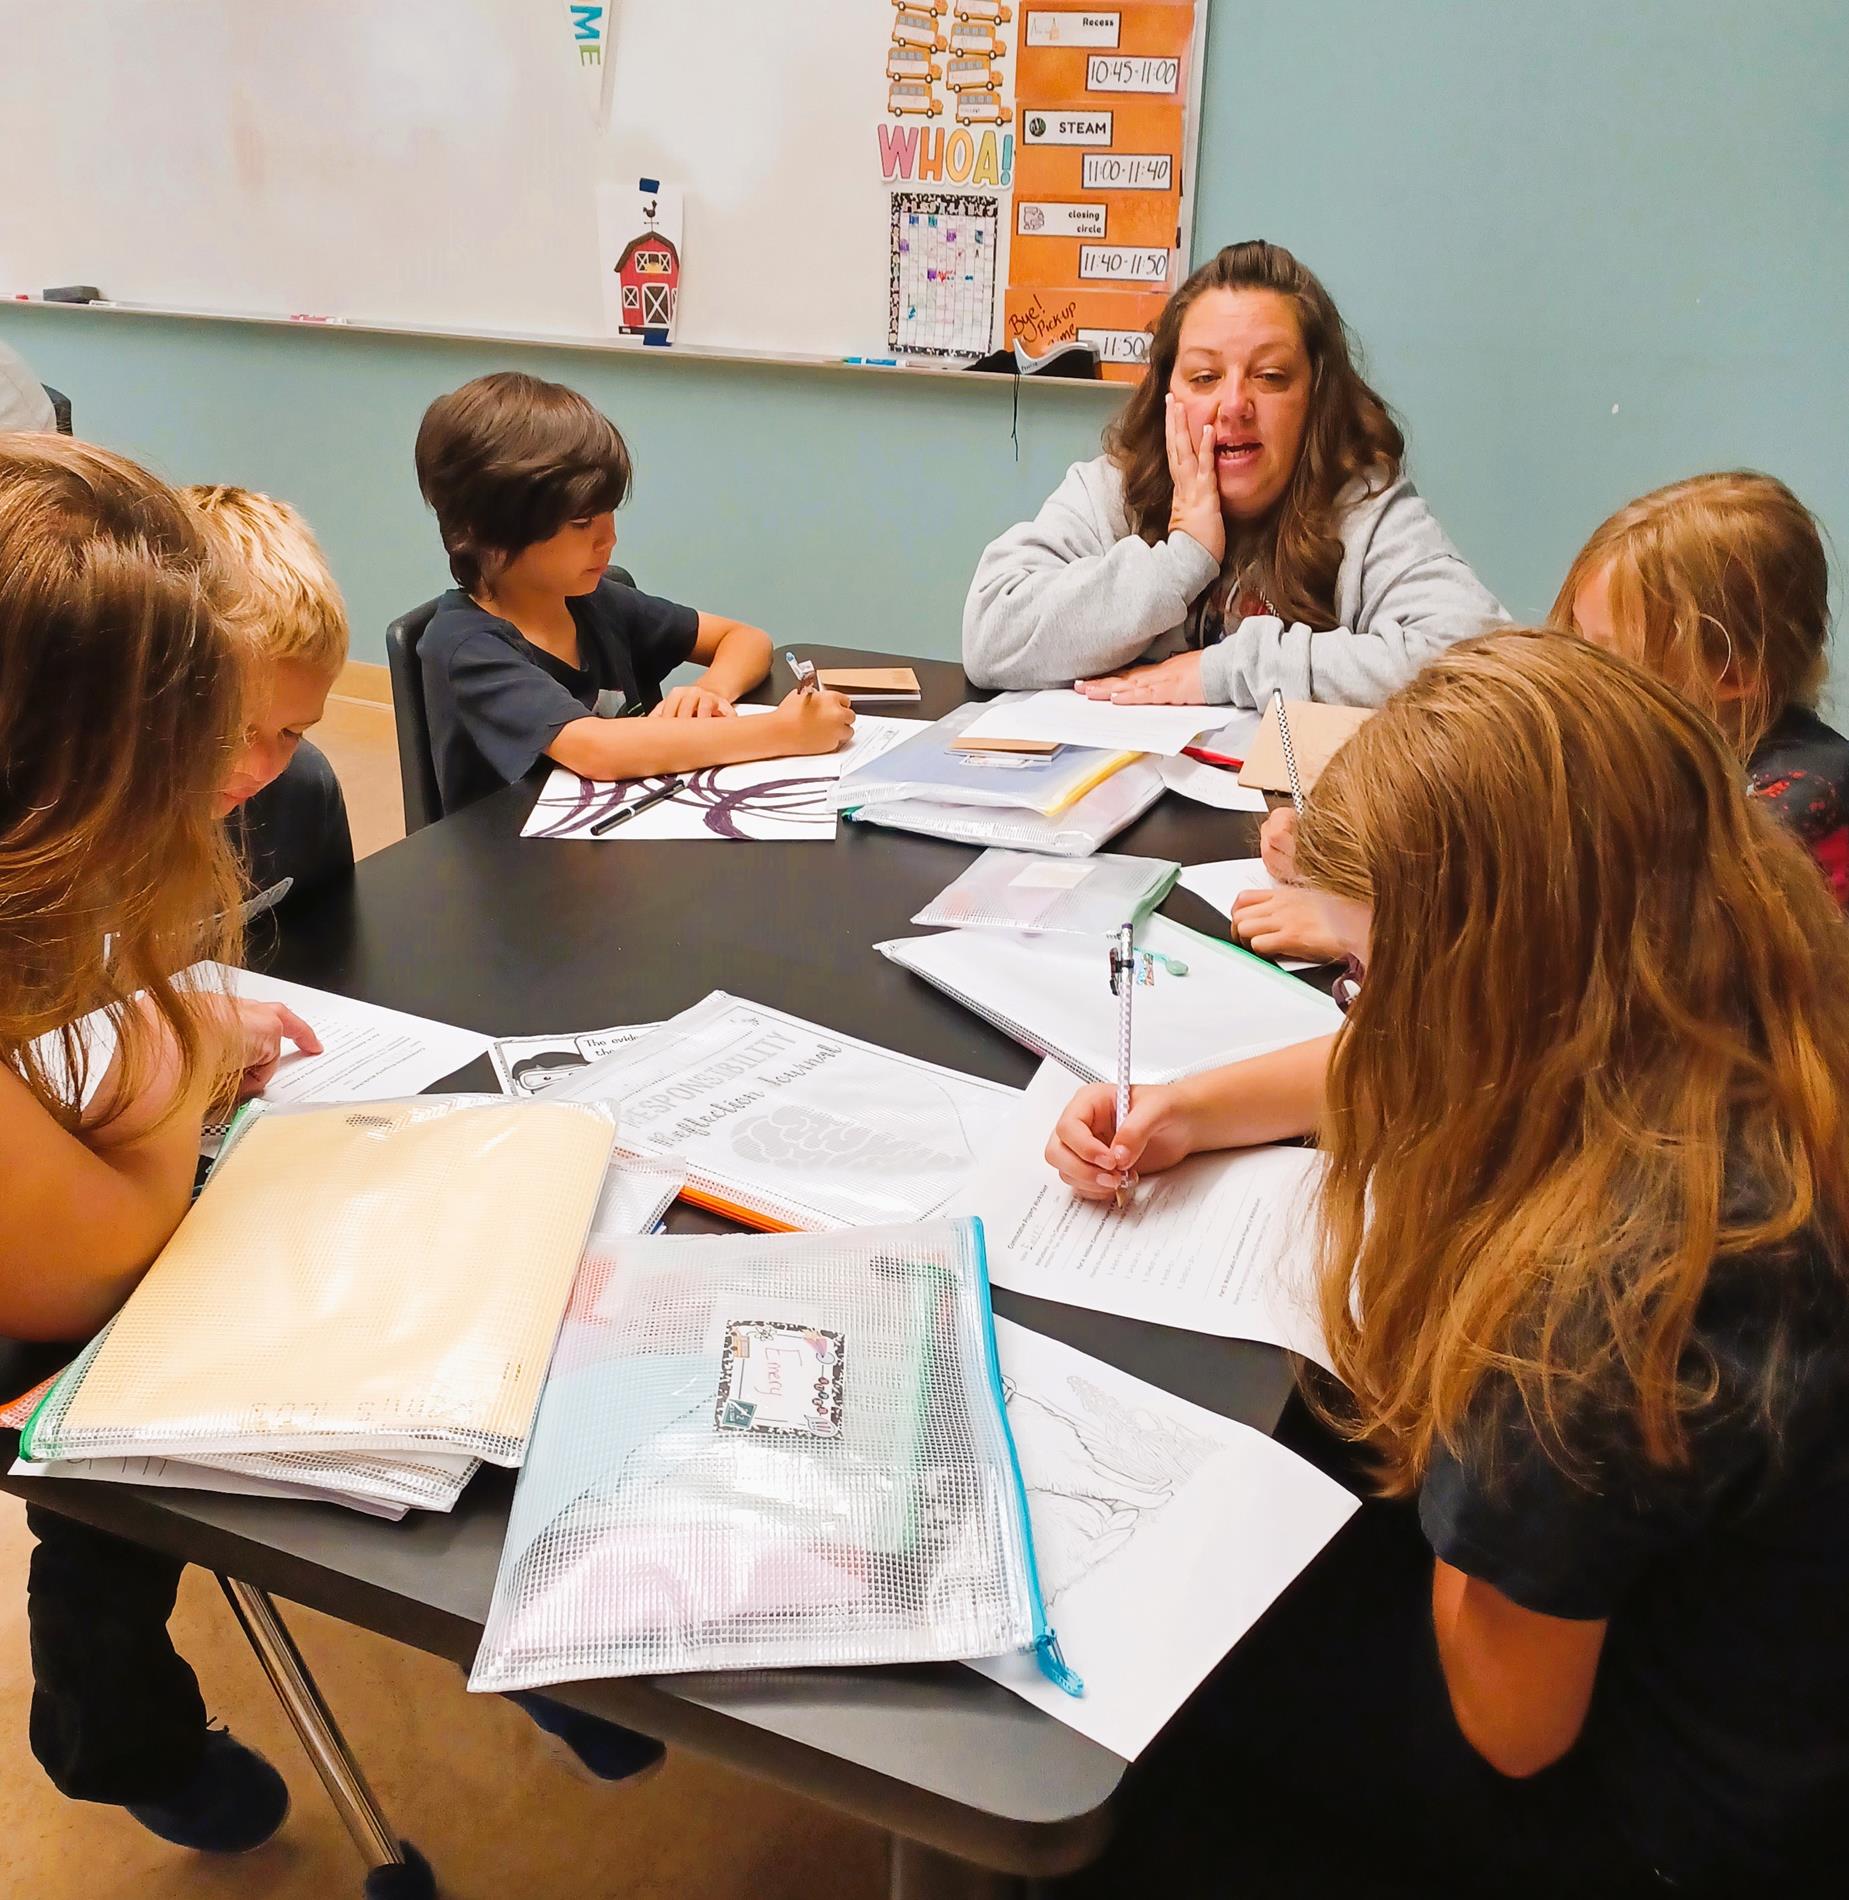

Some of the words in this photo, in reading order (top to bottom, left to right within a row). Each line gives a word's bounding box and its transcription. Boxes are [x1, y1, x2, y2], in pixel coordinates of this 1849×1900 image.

[570, 0, 603, 67] ME
[1082, 17, 1114, 27] Recess
[1058, 122, 1107, 135] STEAM
[877, 123, 1014, 186] WHOA!
[1068, 209, 1101, 221] closing
[1076, 224, 1102, 234] circle
[1008, 293, 1046, 344] Bye!
[1103, 335, 1146, 357] 11:50
[584, 1039, 607, 1048] The
[611, 1034, 639, 1044] evide
[621, 1030, 797, 1129] RESPONSIBILITY
[649, 1089, 765, 1147] Reflection
[757, 1043, 843, 1088] Journal
[754, 1347, 803, 1397] Emery
